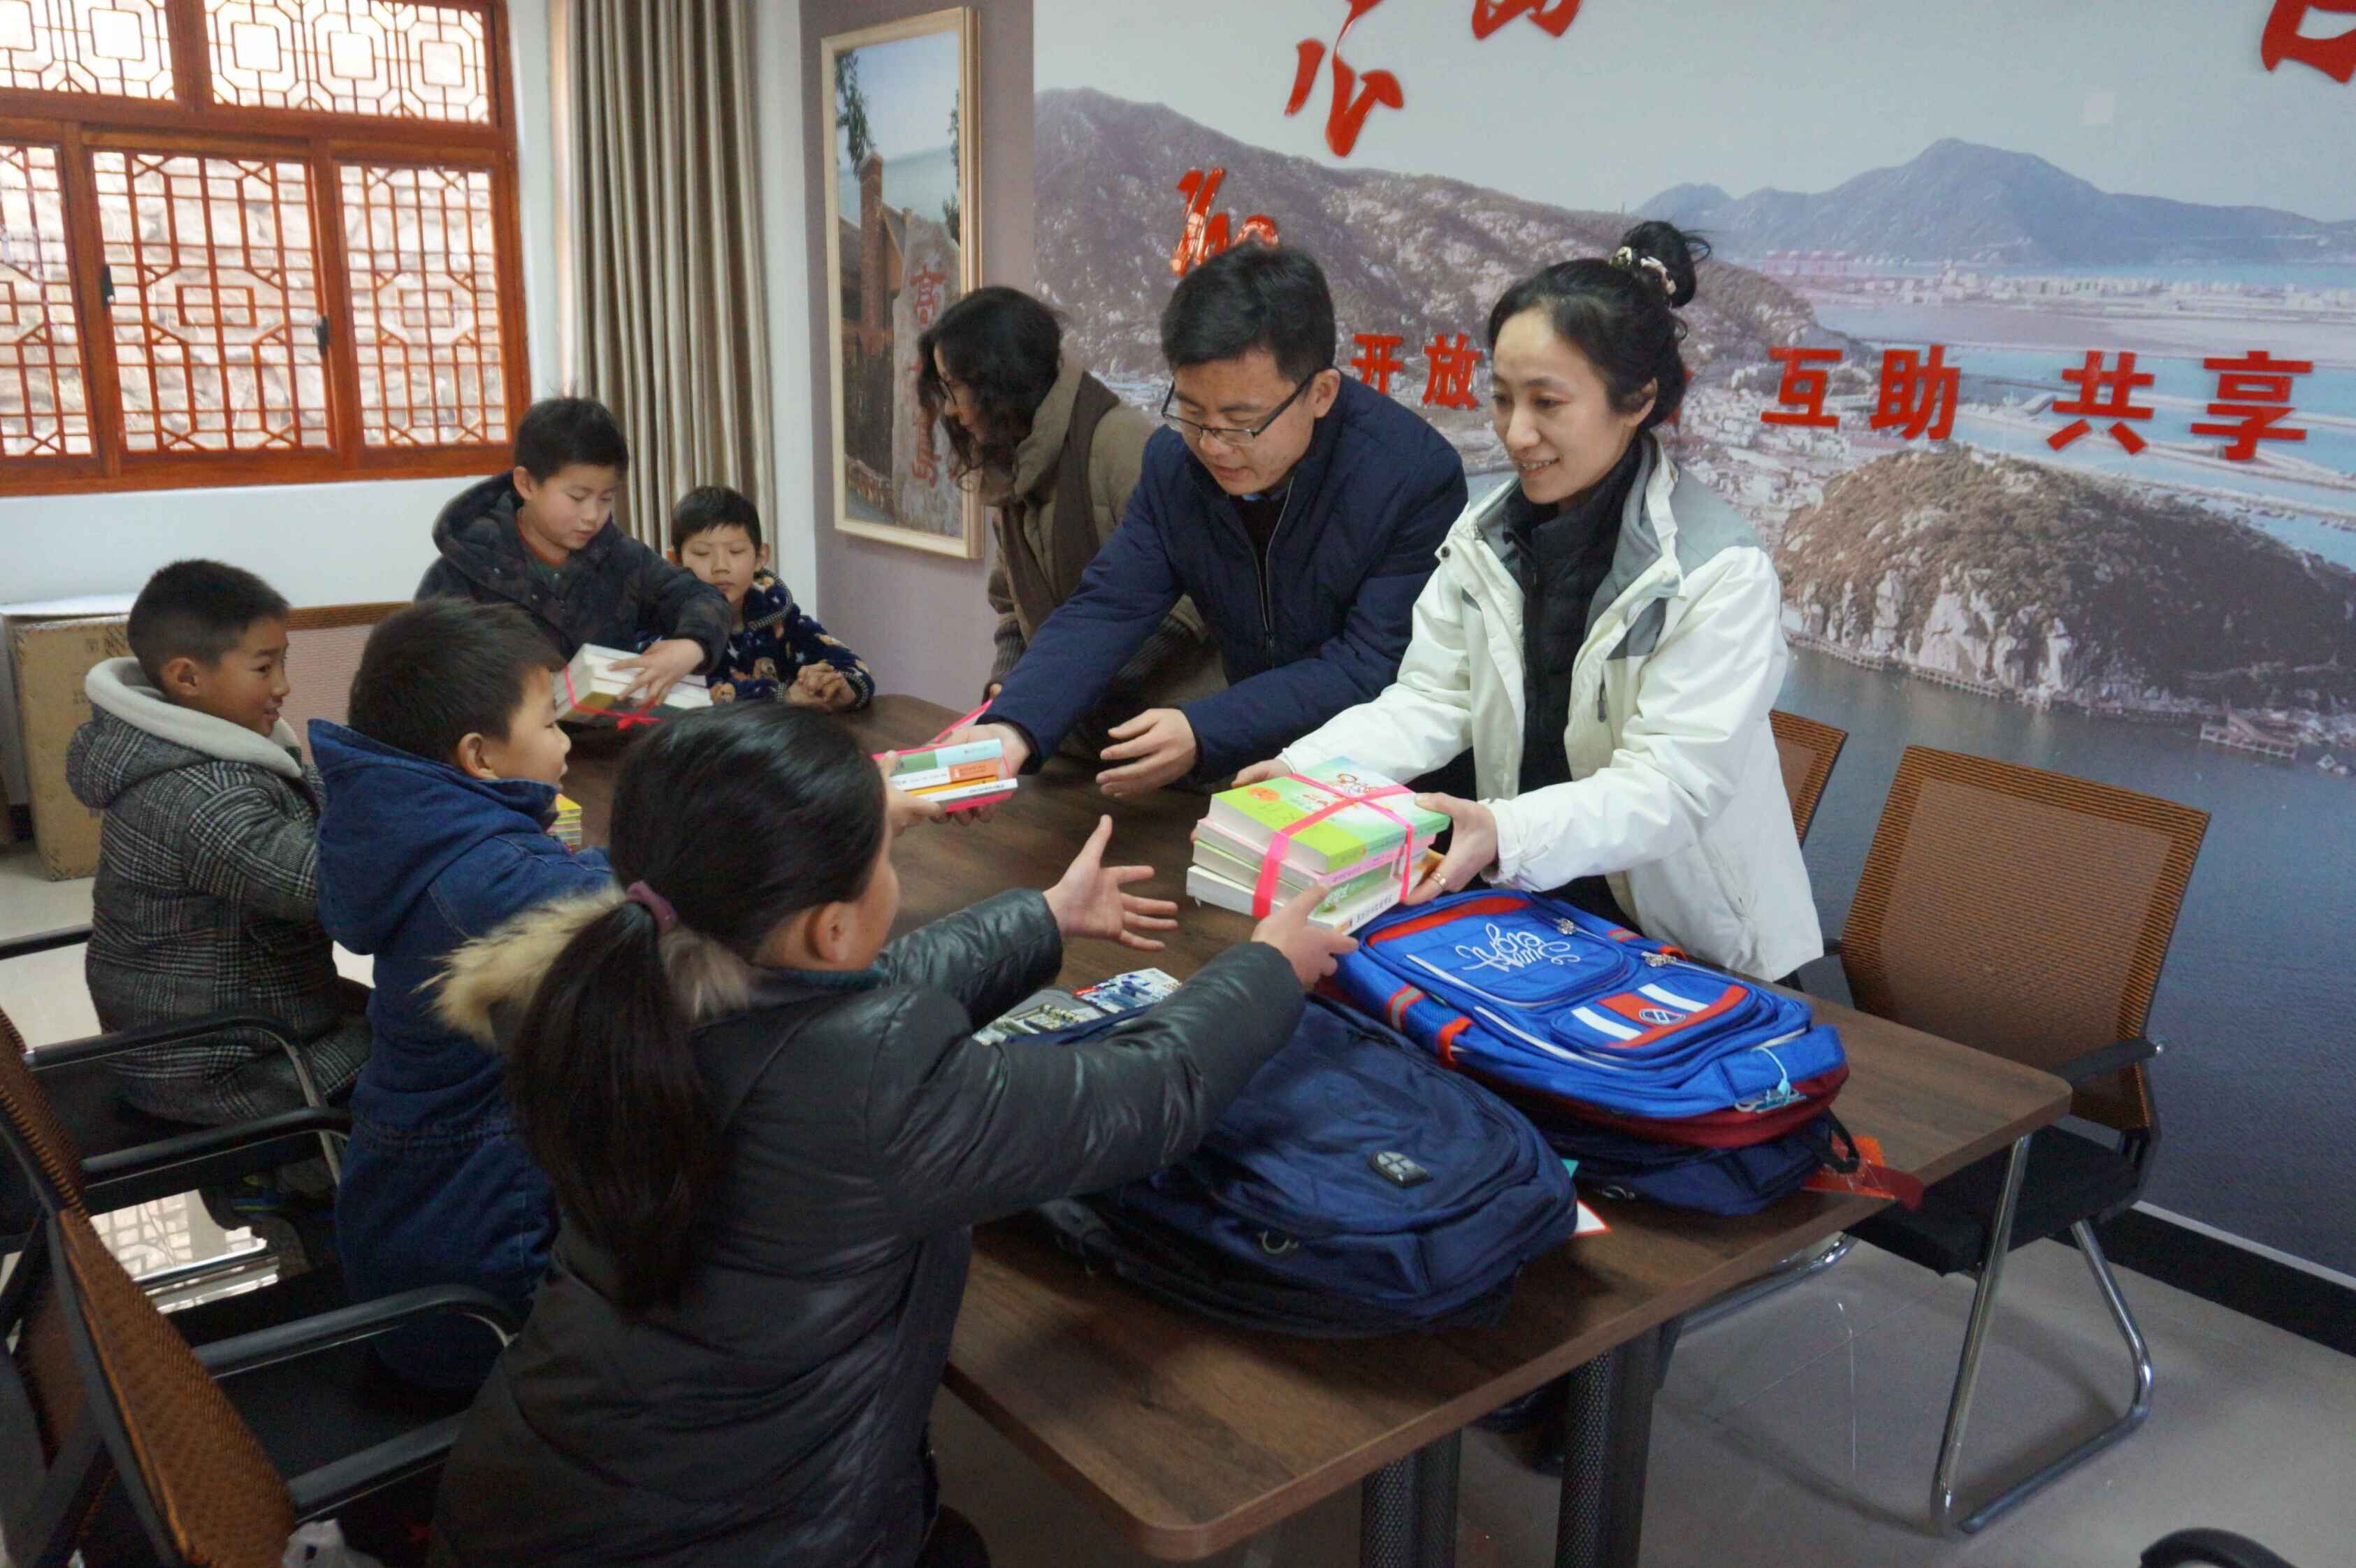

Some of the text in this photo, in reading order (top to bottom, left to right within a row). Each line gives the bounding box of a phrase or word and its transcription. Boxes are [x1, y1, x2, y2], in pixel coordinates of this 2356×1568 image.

[1350, 333, 1482, 411] 开放
[1761, 345, 1960, 440] 互助
[2046, 351, 2313, 460] 共享
